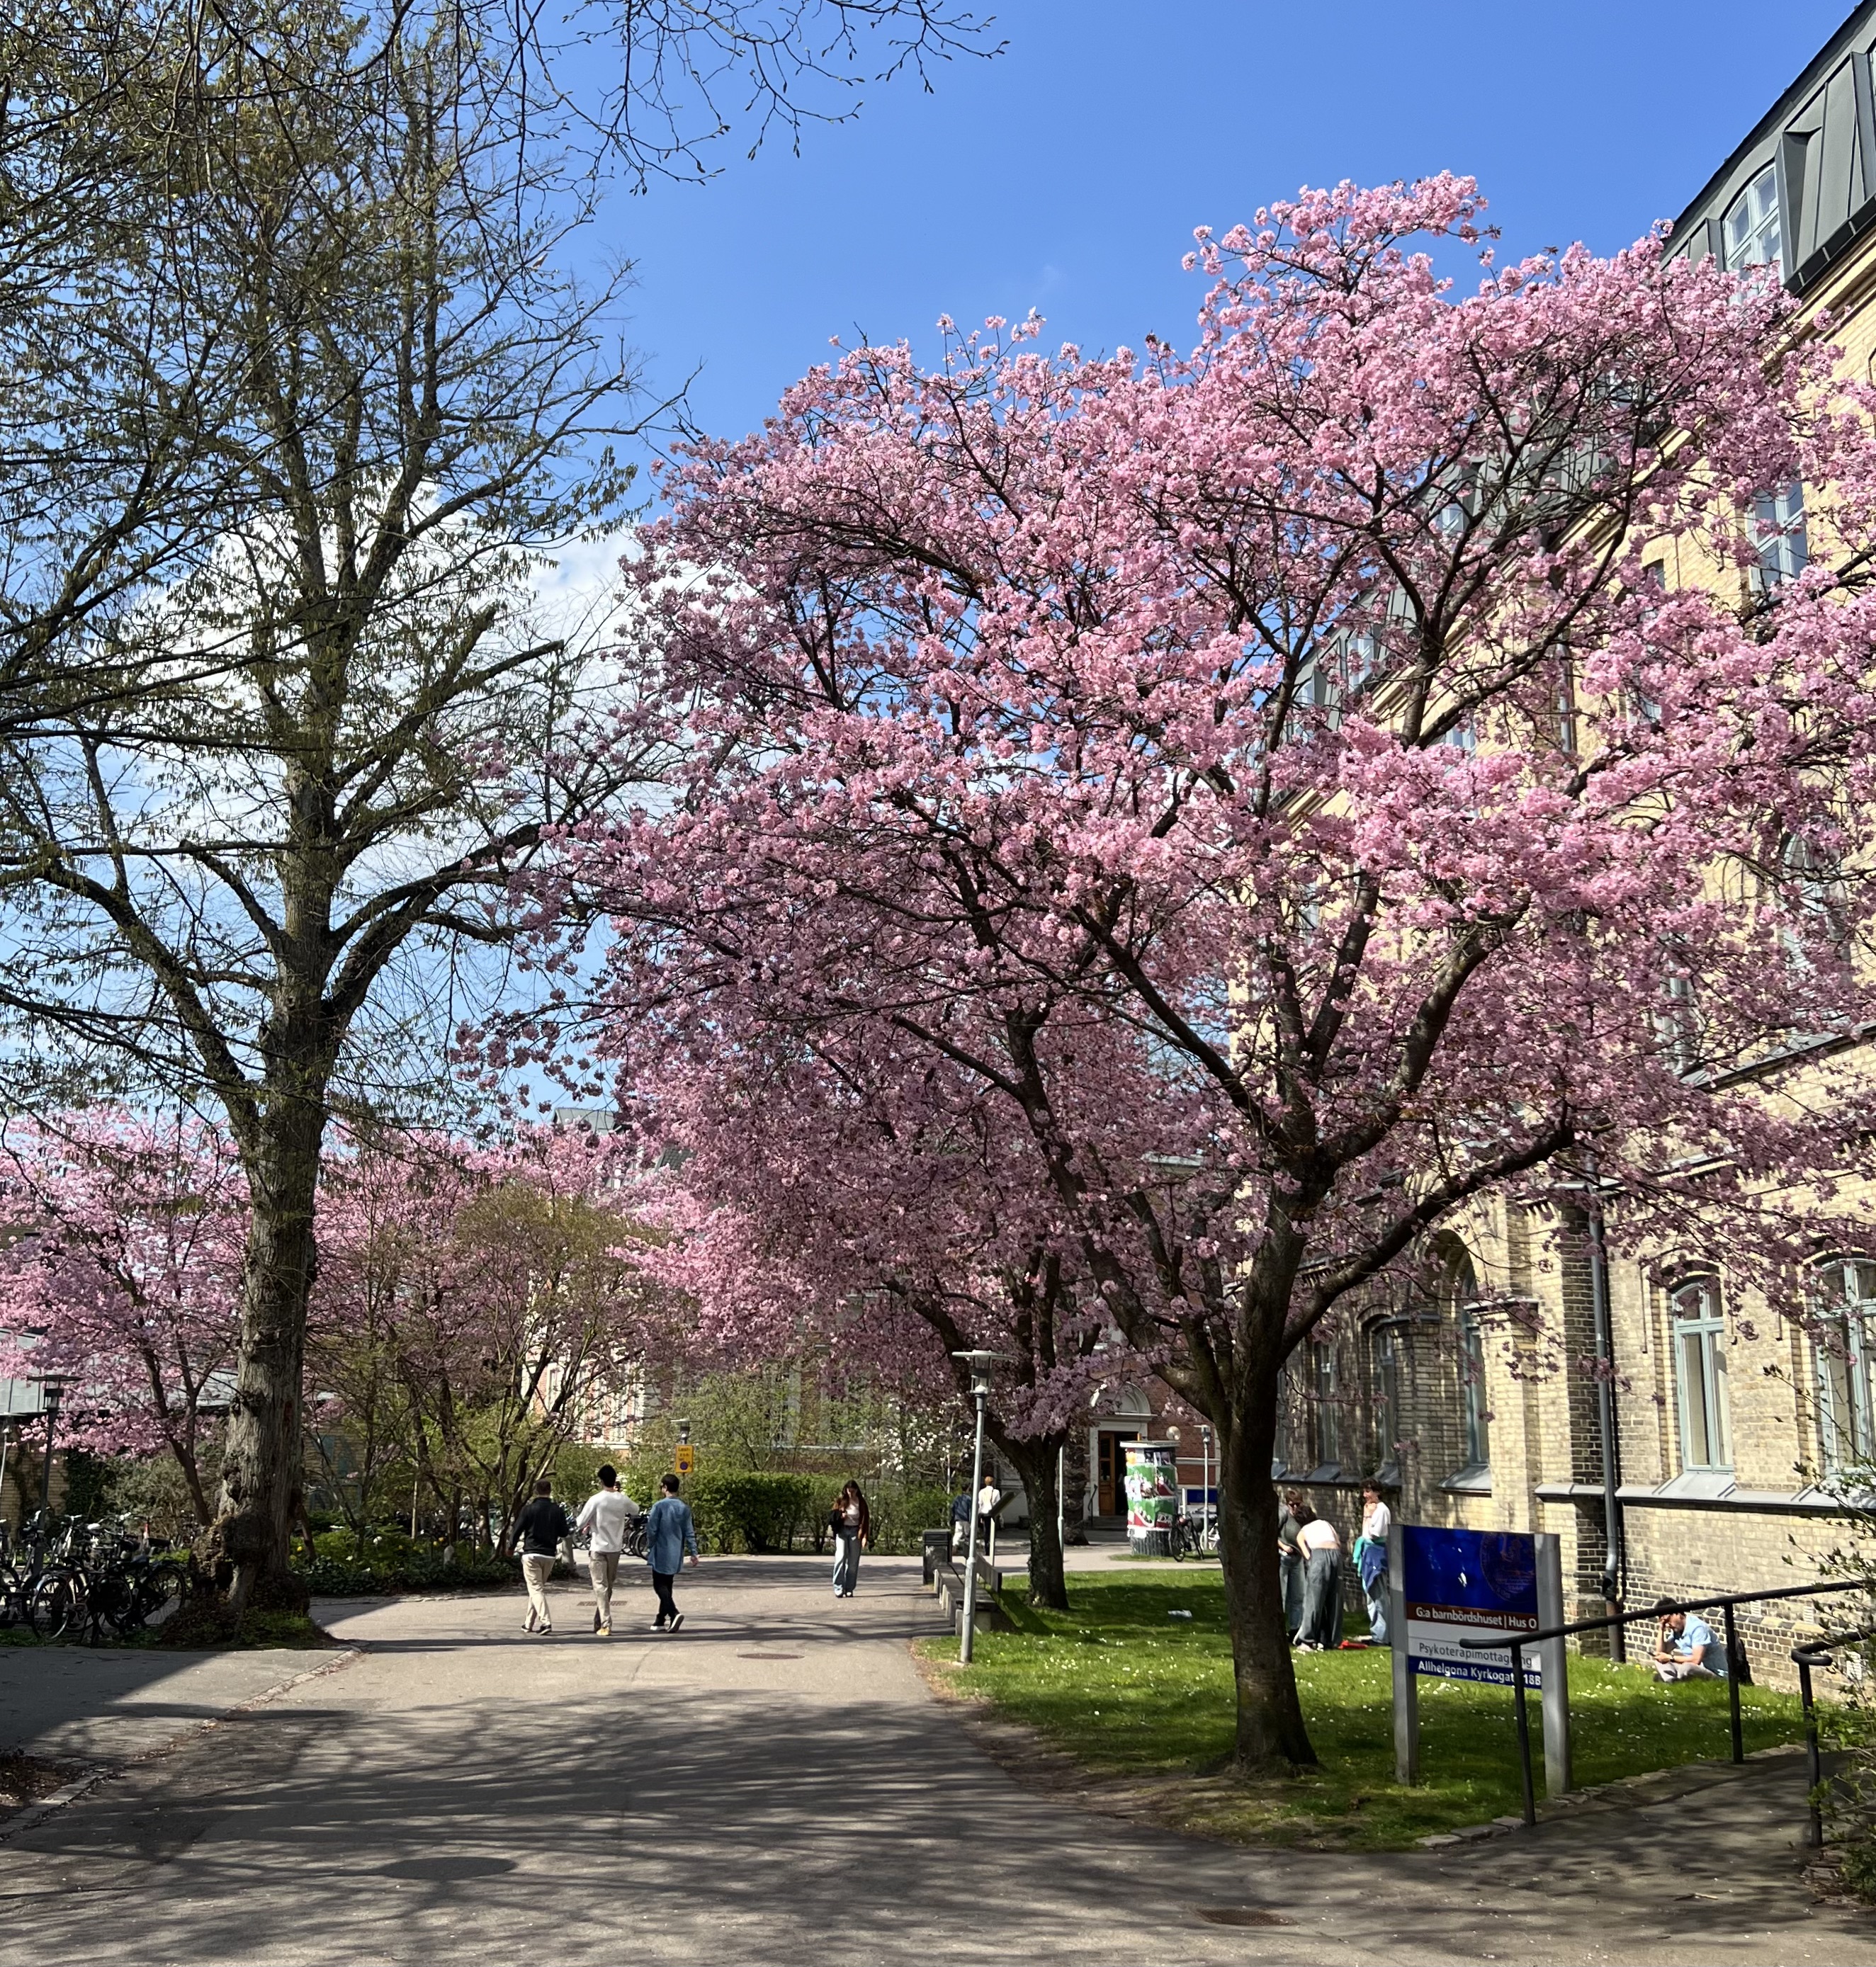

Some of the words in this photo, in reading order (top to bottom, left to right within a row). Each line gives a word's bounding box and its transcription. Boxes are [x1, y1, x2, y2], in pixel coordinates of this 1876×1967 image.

[1416, 1606, 1430, 1619] G:a
[1432, 1607, 1503, 1626] barnbördshuset
[1508, 1616, 1527, 1628] Hus
[1528, 1618, 1537, 1629] O
[1419, 1643, 1532, 1669] Psykoterapimottagng
[1418, 1660, 1469, 1677] Allhelgona
[1470, 1667, 1516, 1684] Kyrkogat
[1522, 1674, 1542, 1686] 18B
